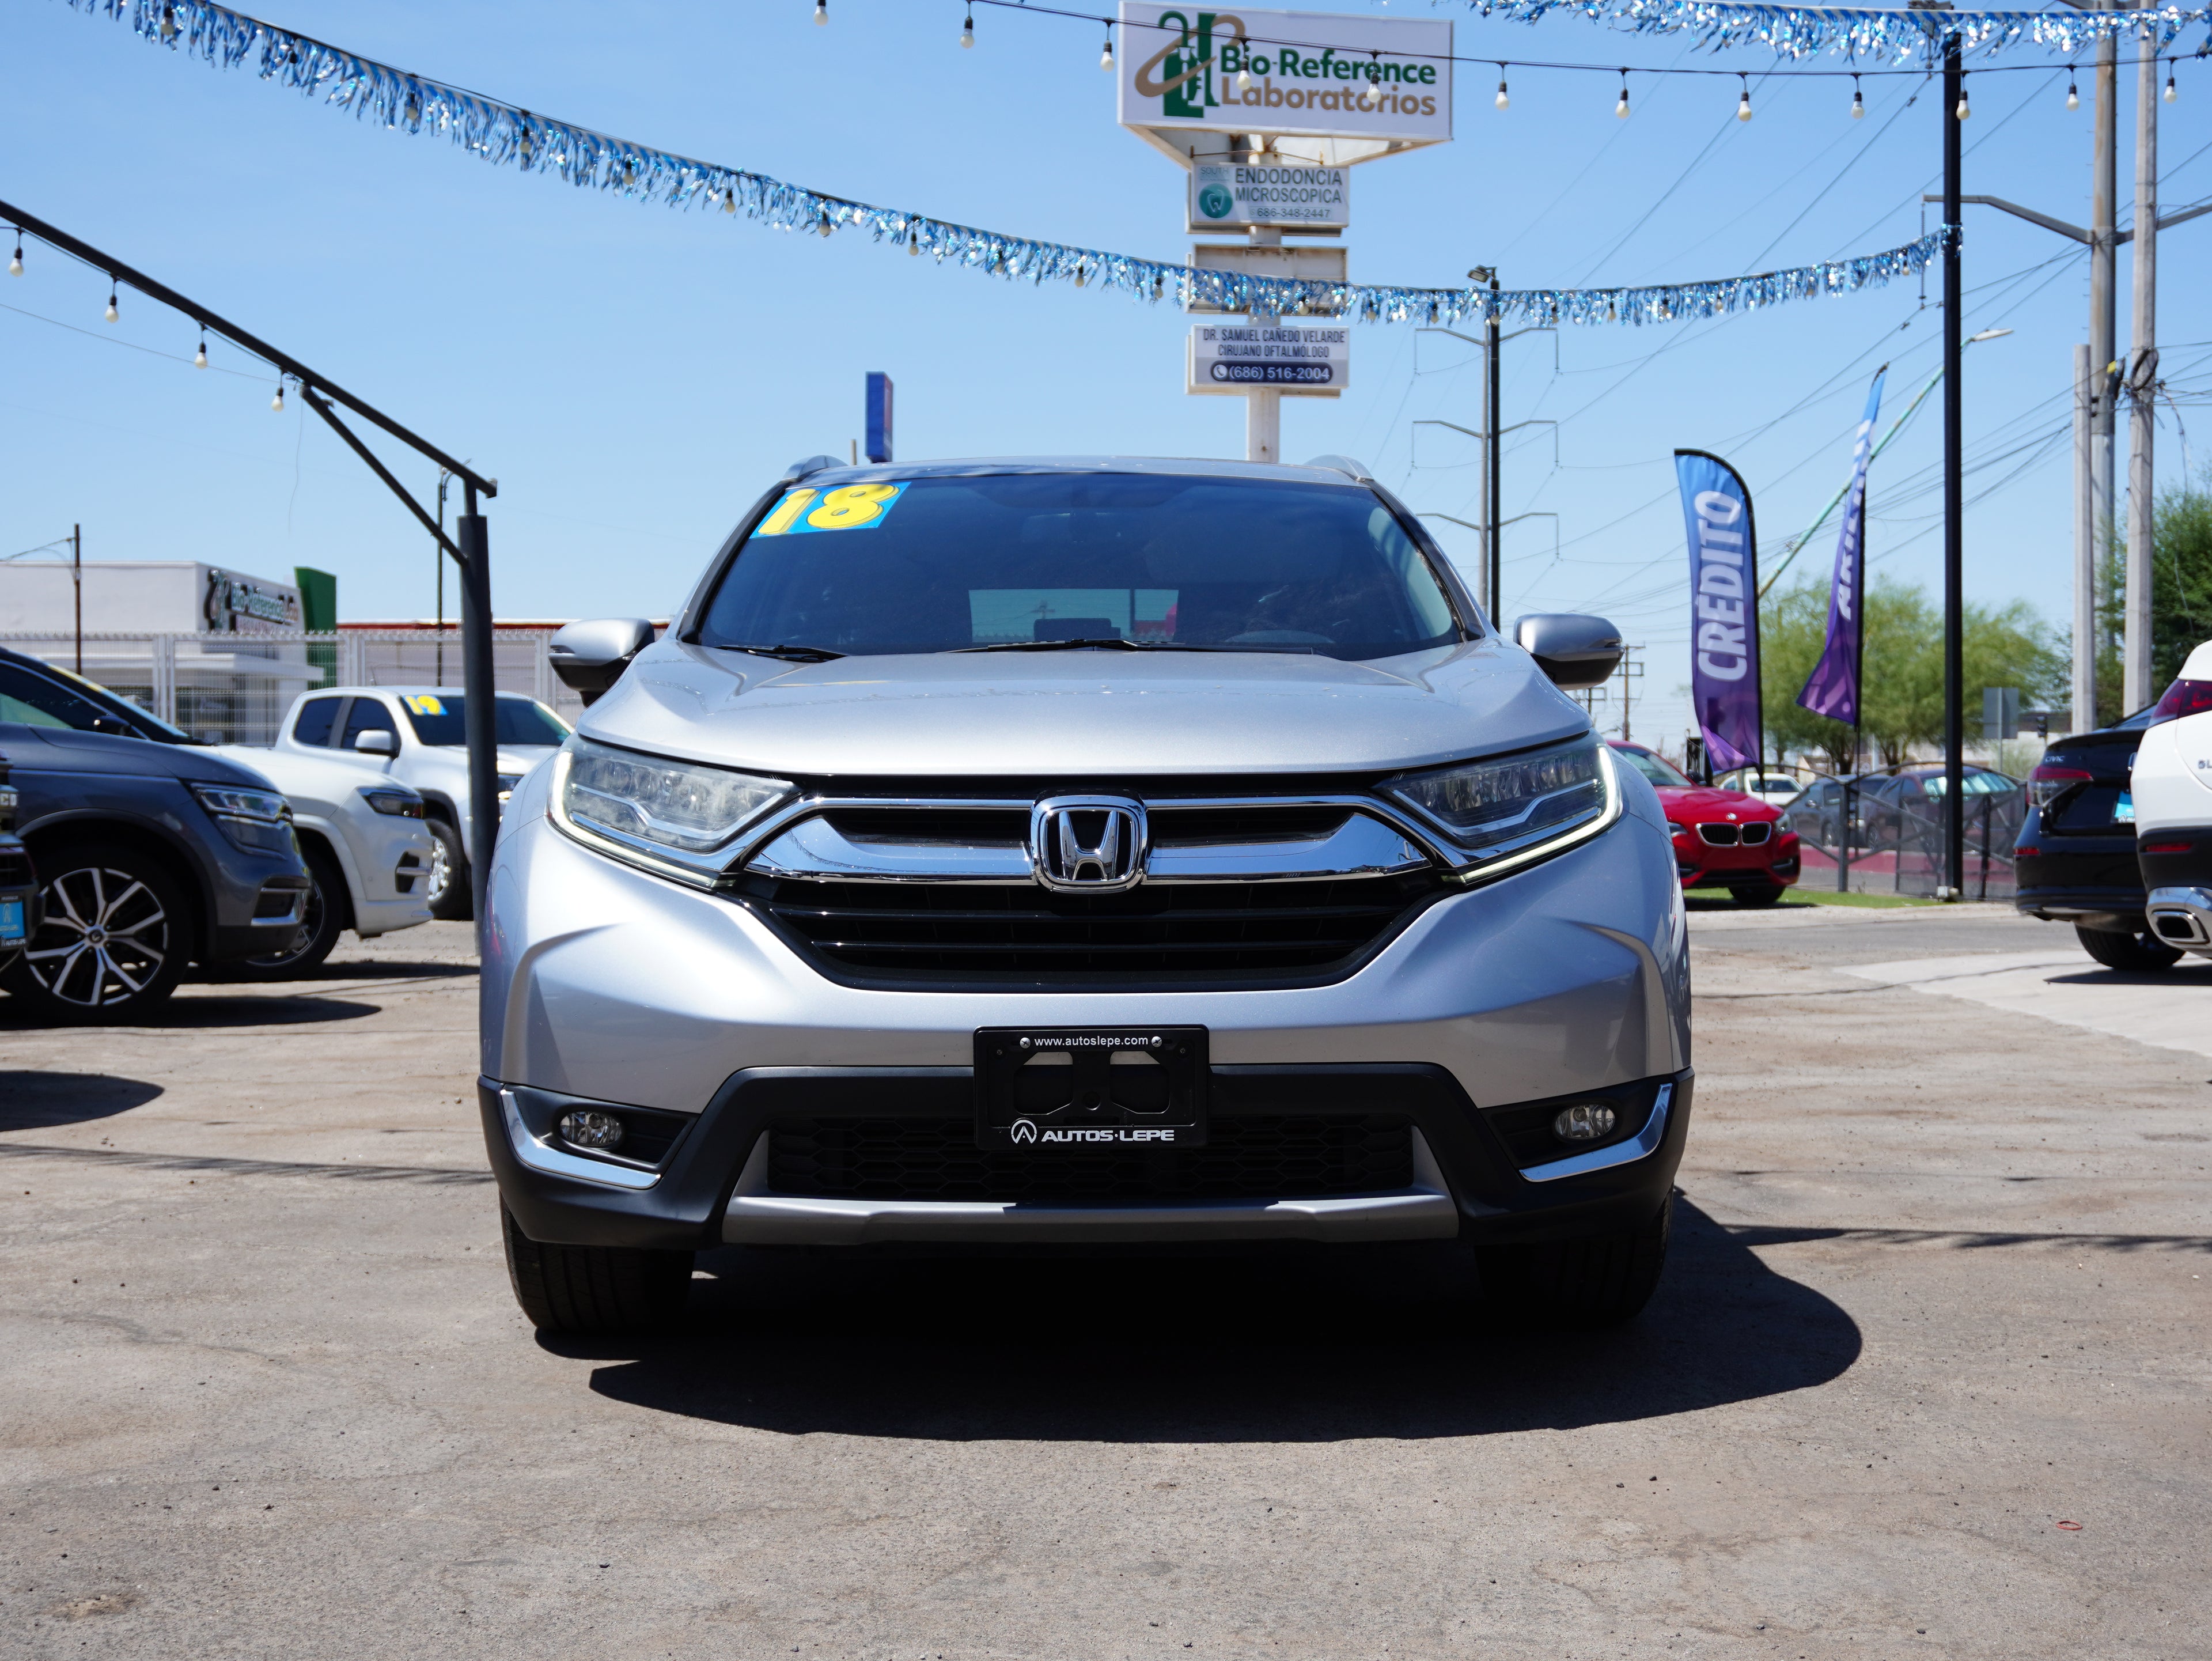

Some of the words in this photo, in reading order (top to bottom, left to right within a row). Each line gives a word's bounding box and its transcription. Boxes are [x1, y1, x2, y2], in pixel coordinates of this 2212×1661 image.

[1221, 76, 1437, 116] Laboratorios
[1235, 168, 1342, 185] ENDODONCIA
[1235, 187, 1342, 203] MICROSCOPICA
[1257, 207, 1331, 218] 686-348-2447
[1203, 328, 1219, 340] DR.
[1222, 328, 1259, 342] SAMUEL
[1263, 327, 1300, 342] CAÑEDO
[1303, 331, 1345, 343] VELARDE
[1218, 345, 1262, 357] CIRUJANO
[1264, 344, 1330, 358] OFTALMÓLOGO
[1229, 366, 1264, 380] (686)
[1267, 366, 1330, 380] 516-2004
[757, 484, 900, 535] 18
[404, 695, 440, 715] 19
[1034, 1035, 1149, 1047] www.autoslepe.com
